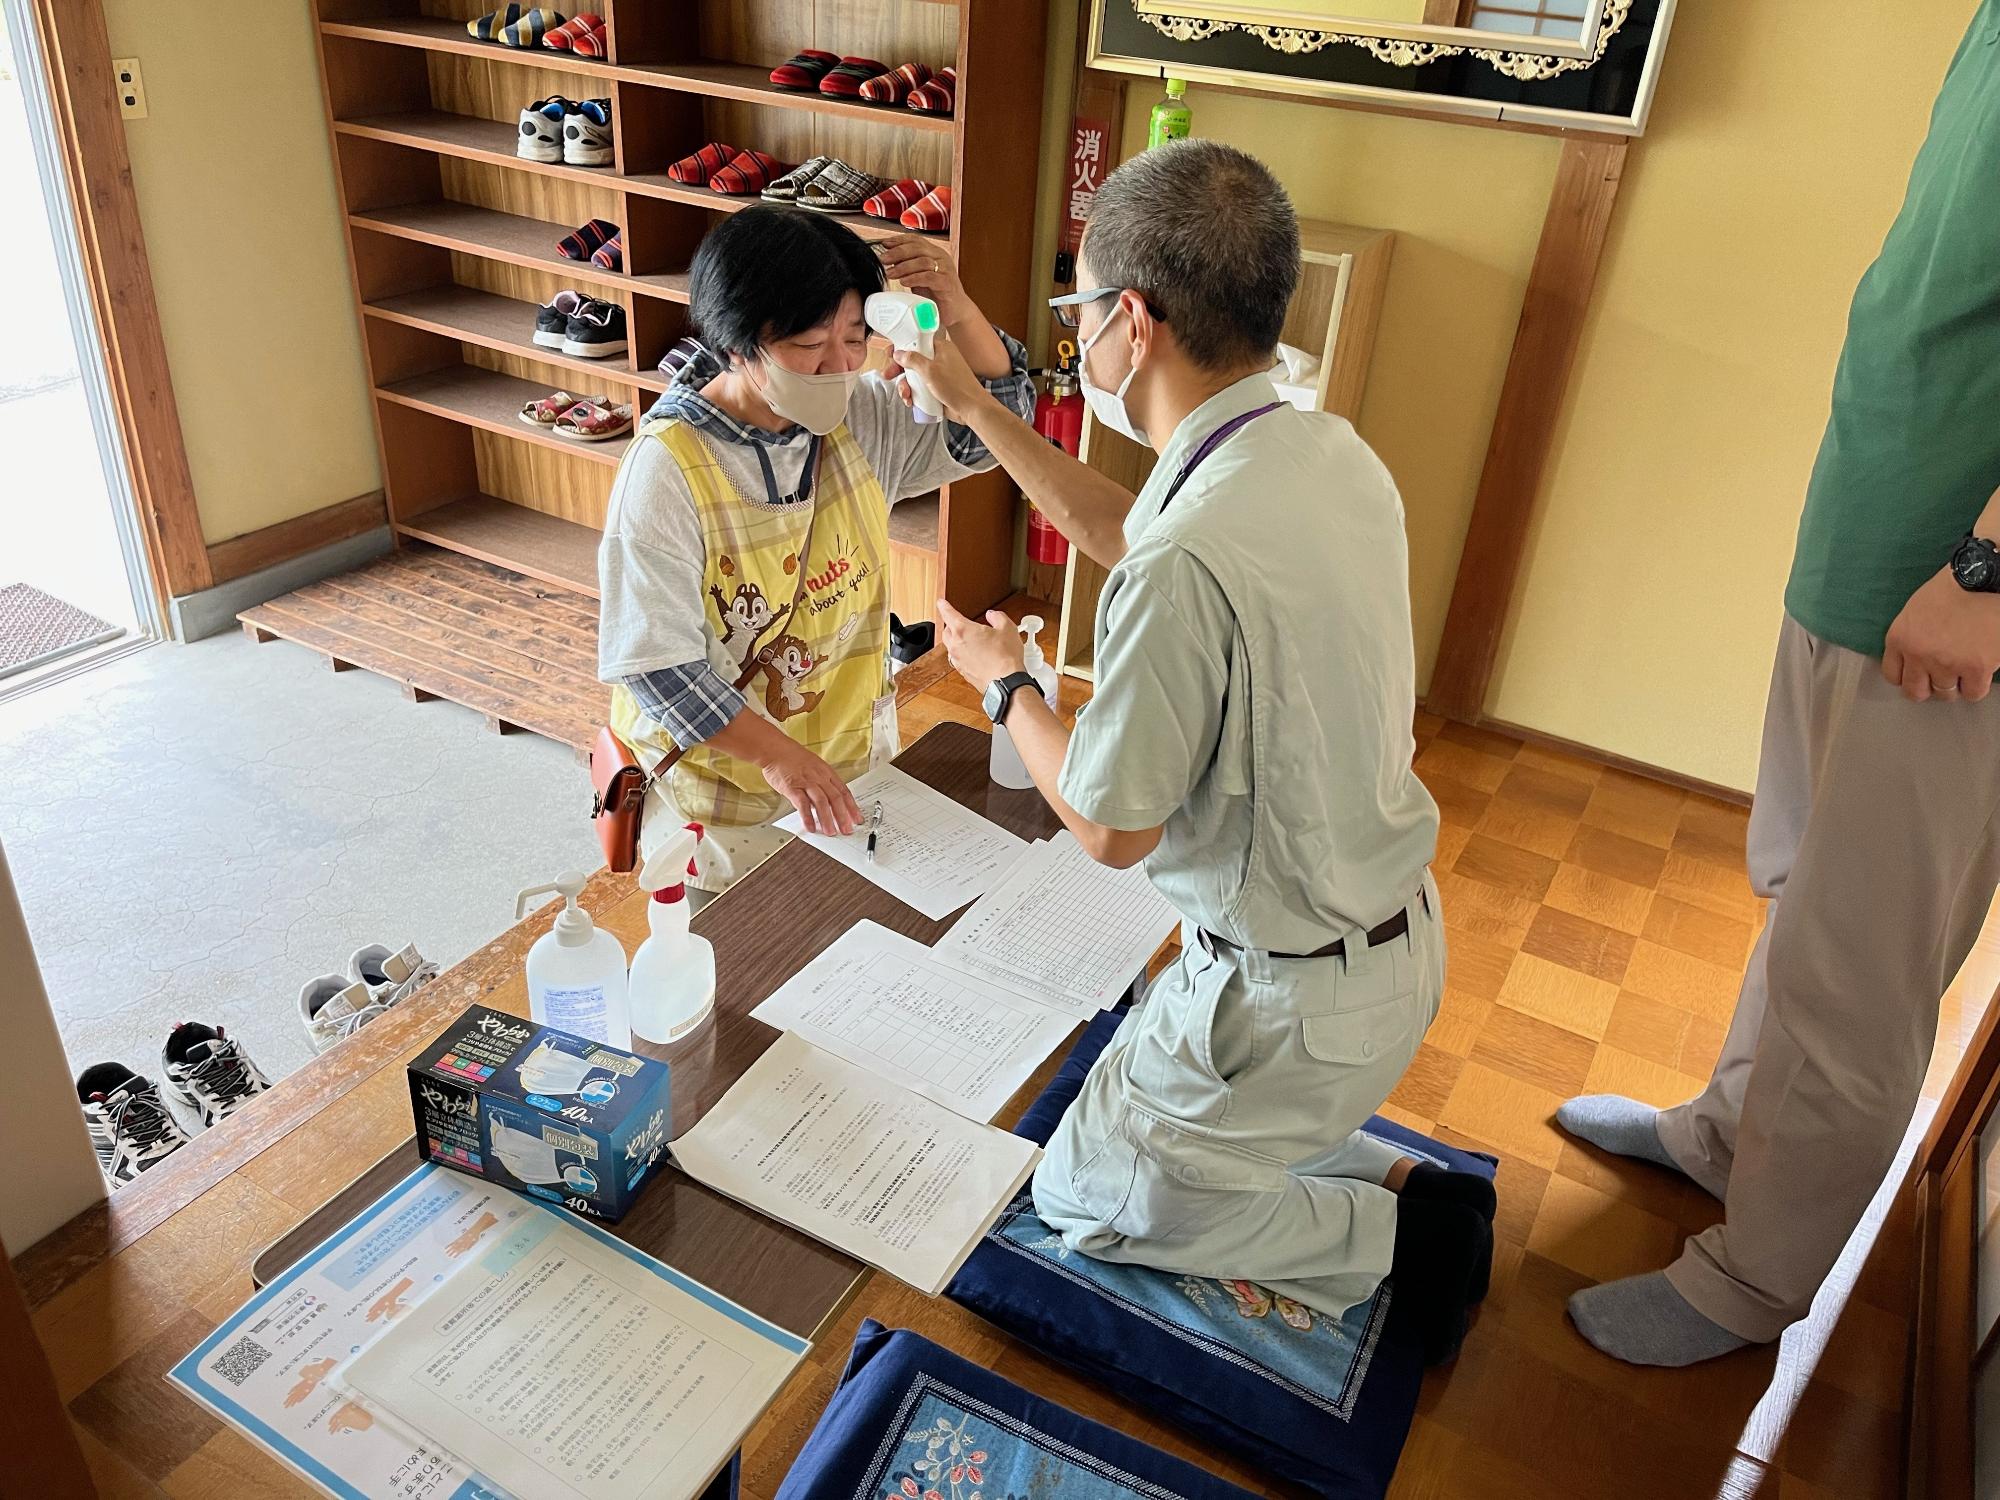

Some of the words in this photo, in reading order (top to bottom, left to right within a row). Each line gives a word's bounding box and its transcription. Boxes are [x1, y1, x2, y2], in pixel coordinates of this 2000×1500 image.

[1070, 129, 1102, 222] 消火器
[807, 557, 850, 593] nuts
[809, 589, 845, 616] about
[849, 561, 870, 592] you!
[477, 1015, 530, 1039] やわらか
[466, 1031, 516, 1052] 3層立体構造で
[590, 1054, 638, 1075] 個別包装
[545, 1132, 596, 1156] 個別包装
